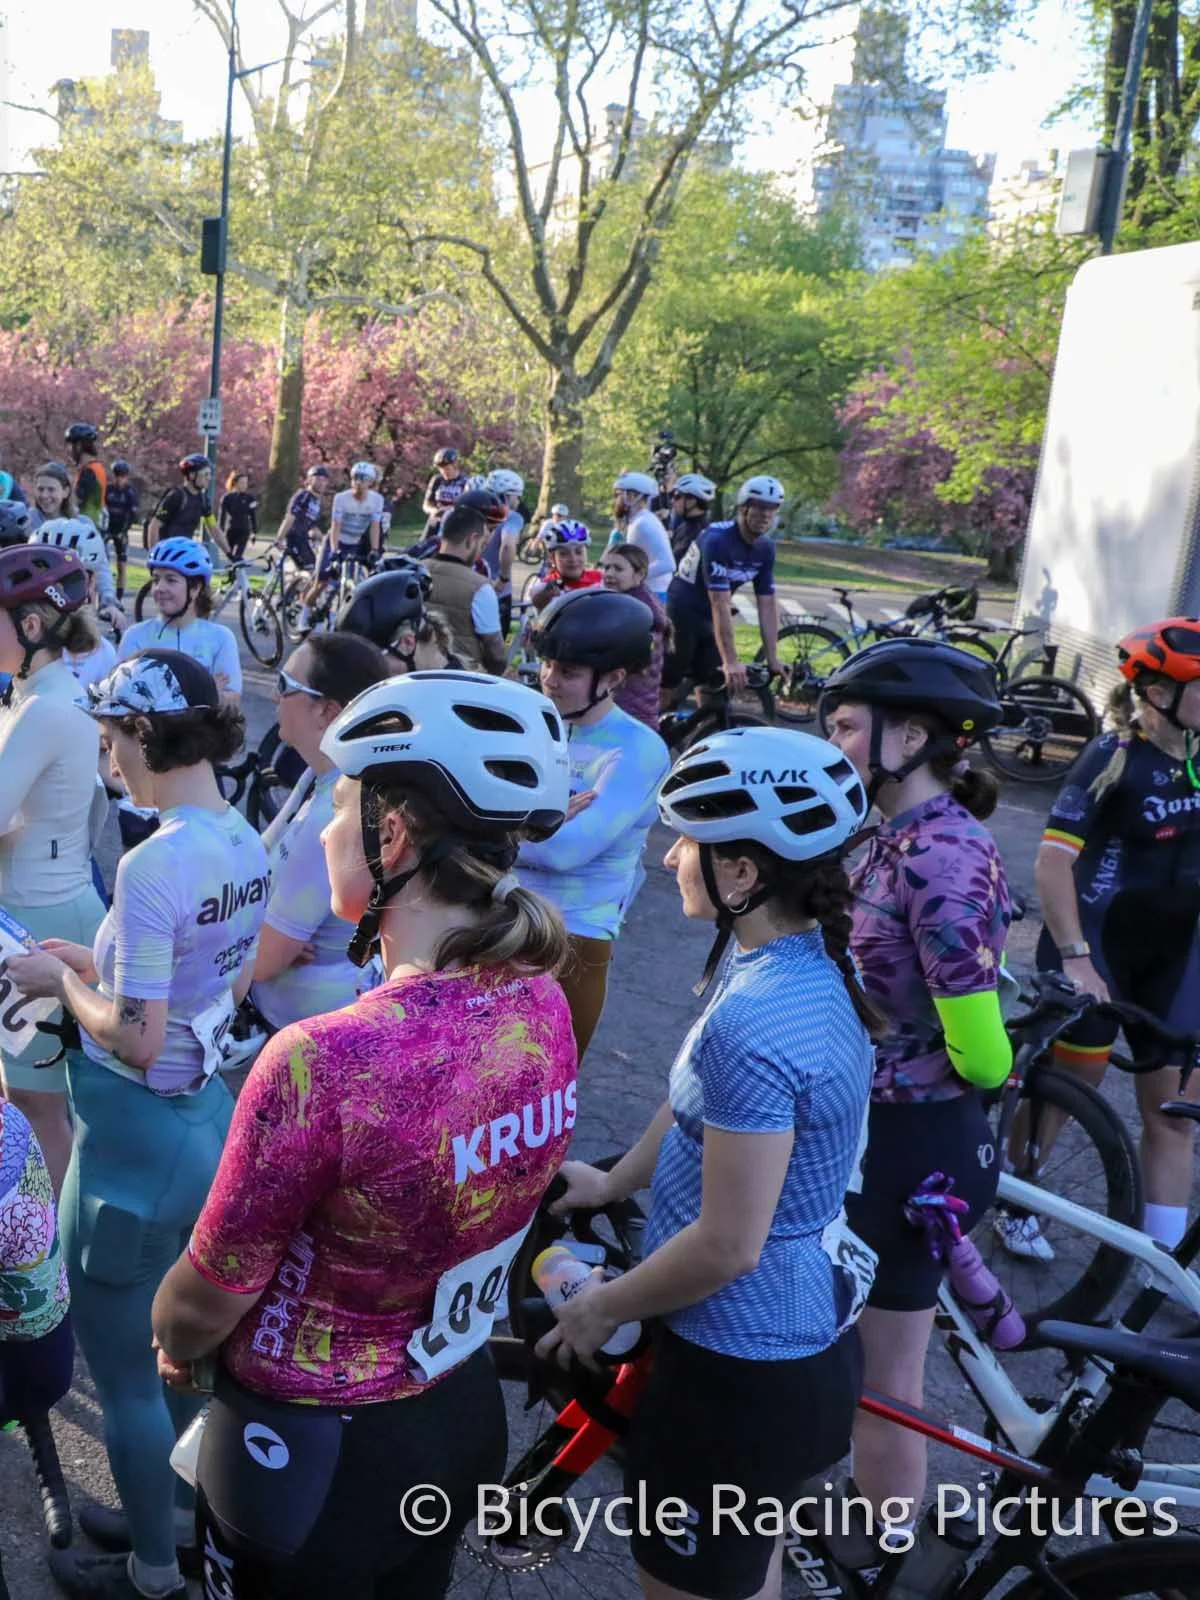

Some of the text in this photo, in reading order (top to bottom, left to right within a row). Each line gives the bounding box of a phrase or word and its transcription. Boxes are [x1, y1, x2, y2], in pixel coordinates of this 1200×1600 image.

[372, 743, 412, 753] TREK
[741, 769, 809, 786] KASK
[196, 869, 272, 926] allway
[465, 978, 525, 1009] PACTIMO
